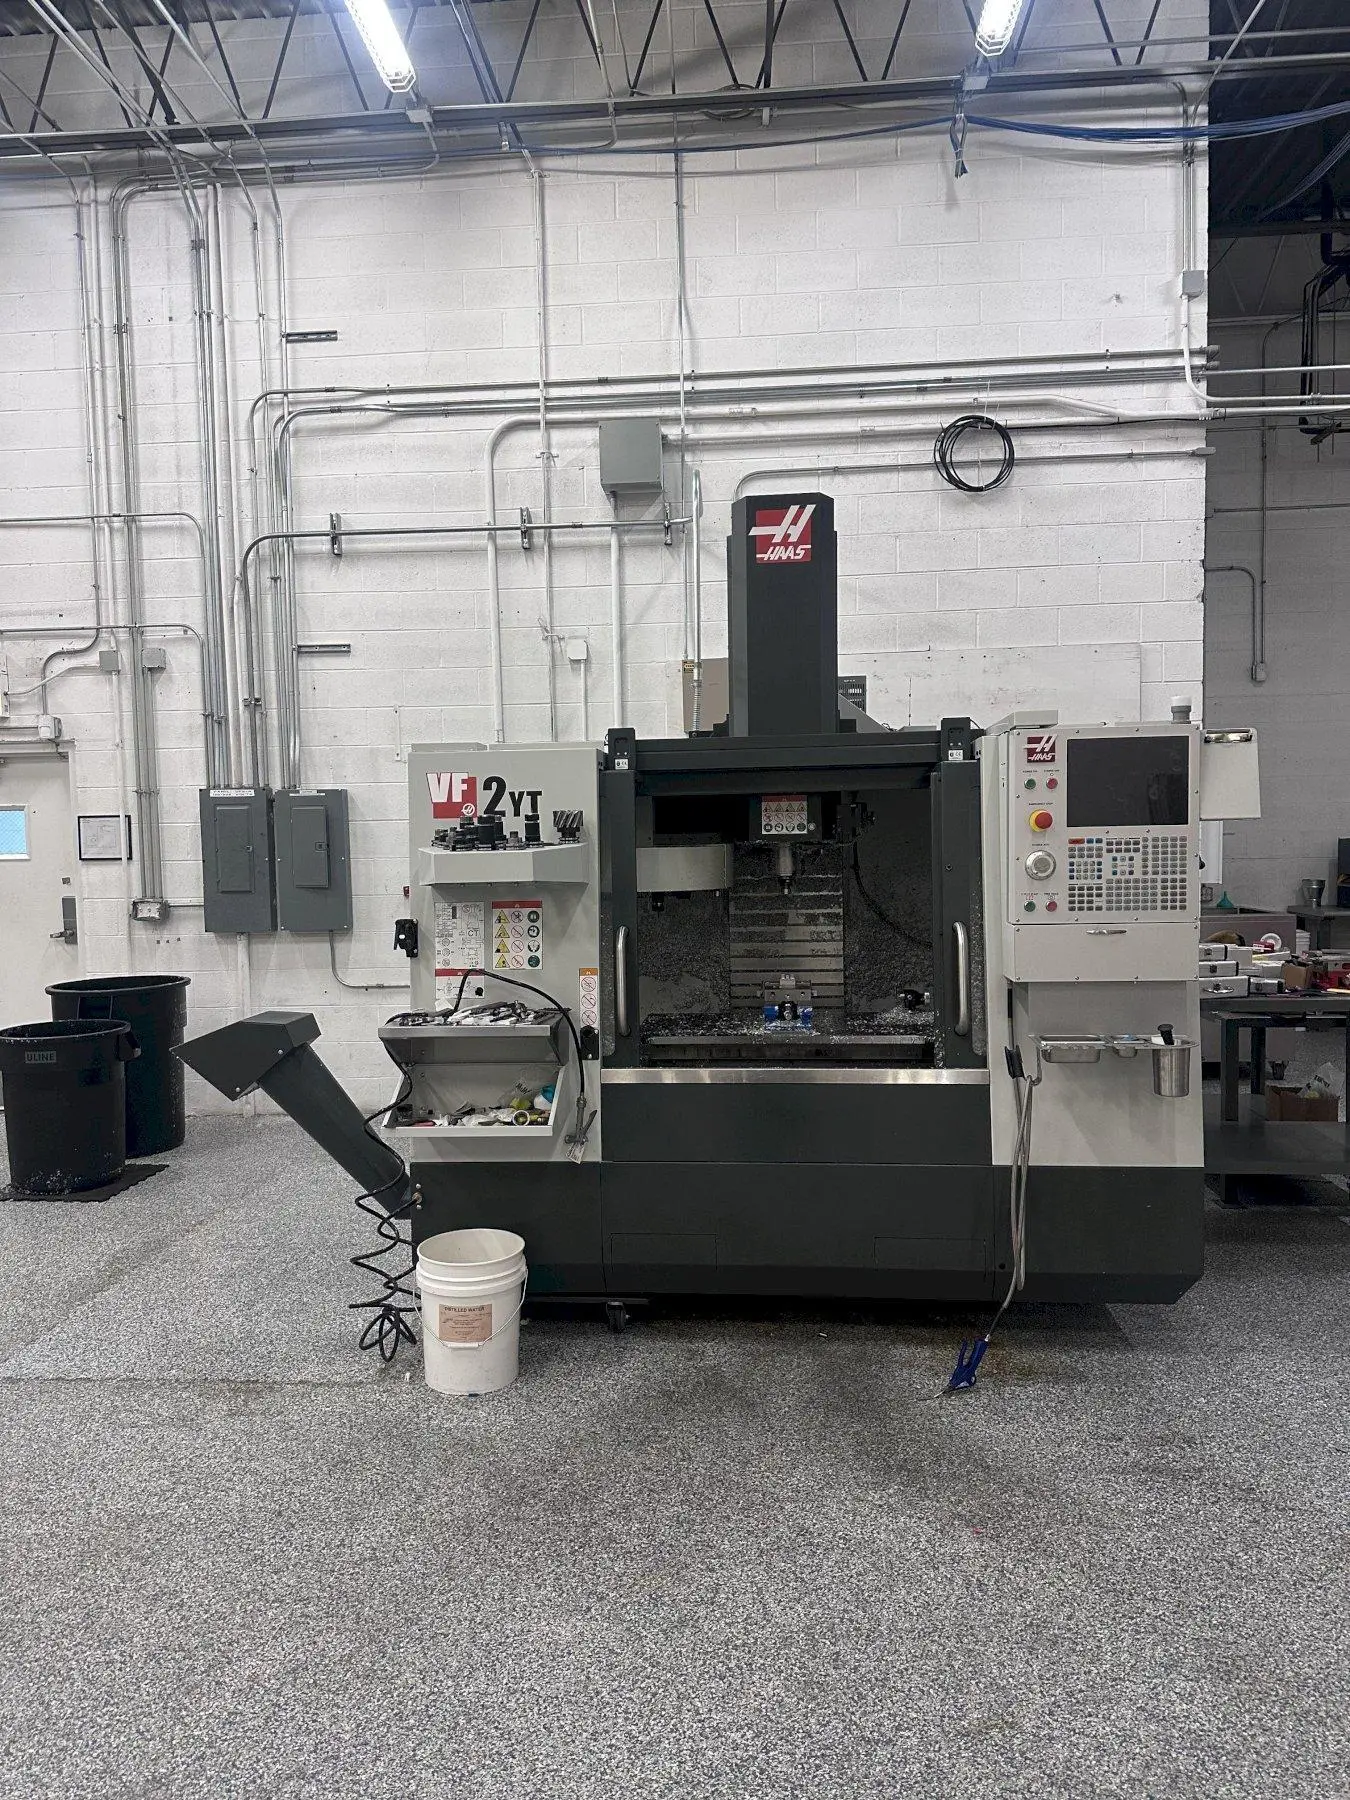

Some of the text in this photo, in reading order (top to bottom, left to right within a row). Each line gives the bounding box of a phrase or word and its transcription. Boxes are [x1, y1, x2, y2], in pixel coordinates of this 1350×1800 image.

[756, 545, 811, 560] HAAS
[1027, 753, 1055, 761] HAAS
[426, 772, 469, 803] VF
